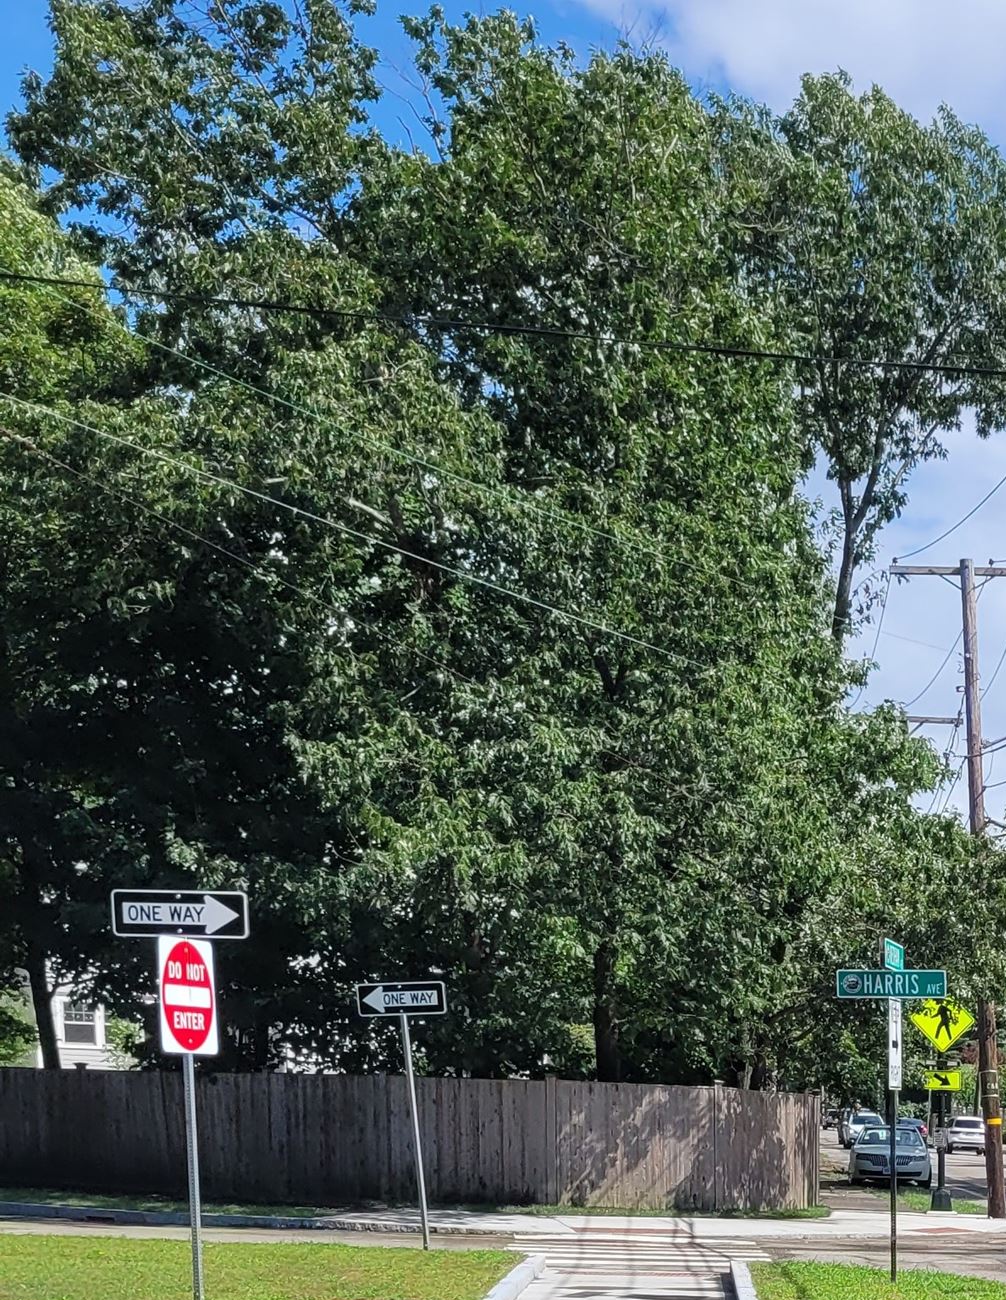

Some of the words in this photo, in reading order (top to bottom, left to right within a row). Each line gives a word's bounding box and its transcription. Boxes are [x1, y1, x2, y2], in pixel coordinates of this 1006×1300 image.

[127, 904, 163, 922] ONE
[168, 905, 205, 923] WAY
[168, 960, 182, 979] DO
[186, 962, 205, 982] NOT
[863, 974, 919, 995] HARRIS
[926, 983, 941, 995] AVE
[383, 992, 407, 1005] ONE
[410, 991, 435, 1004] WAY
[173, 1011, 205, 1031] ENTER
